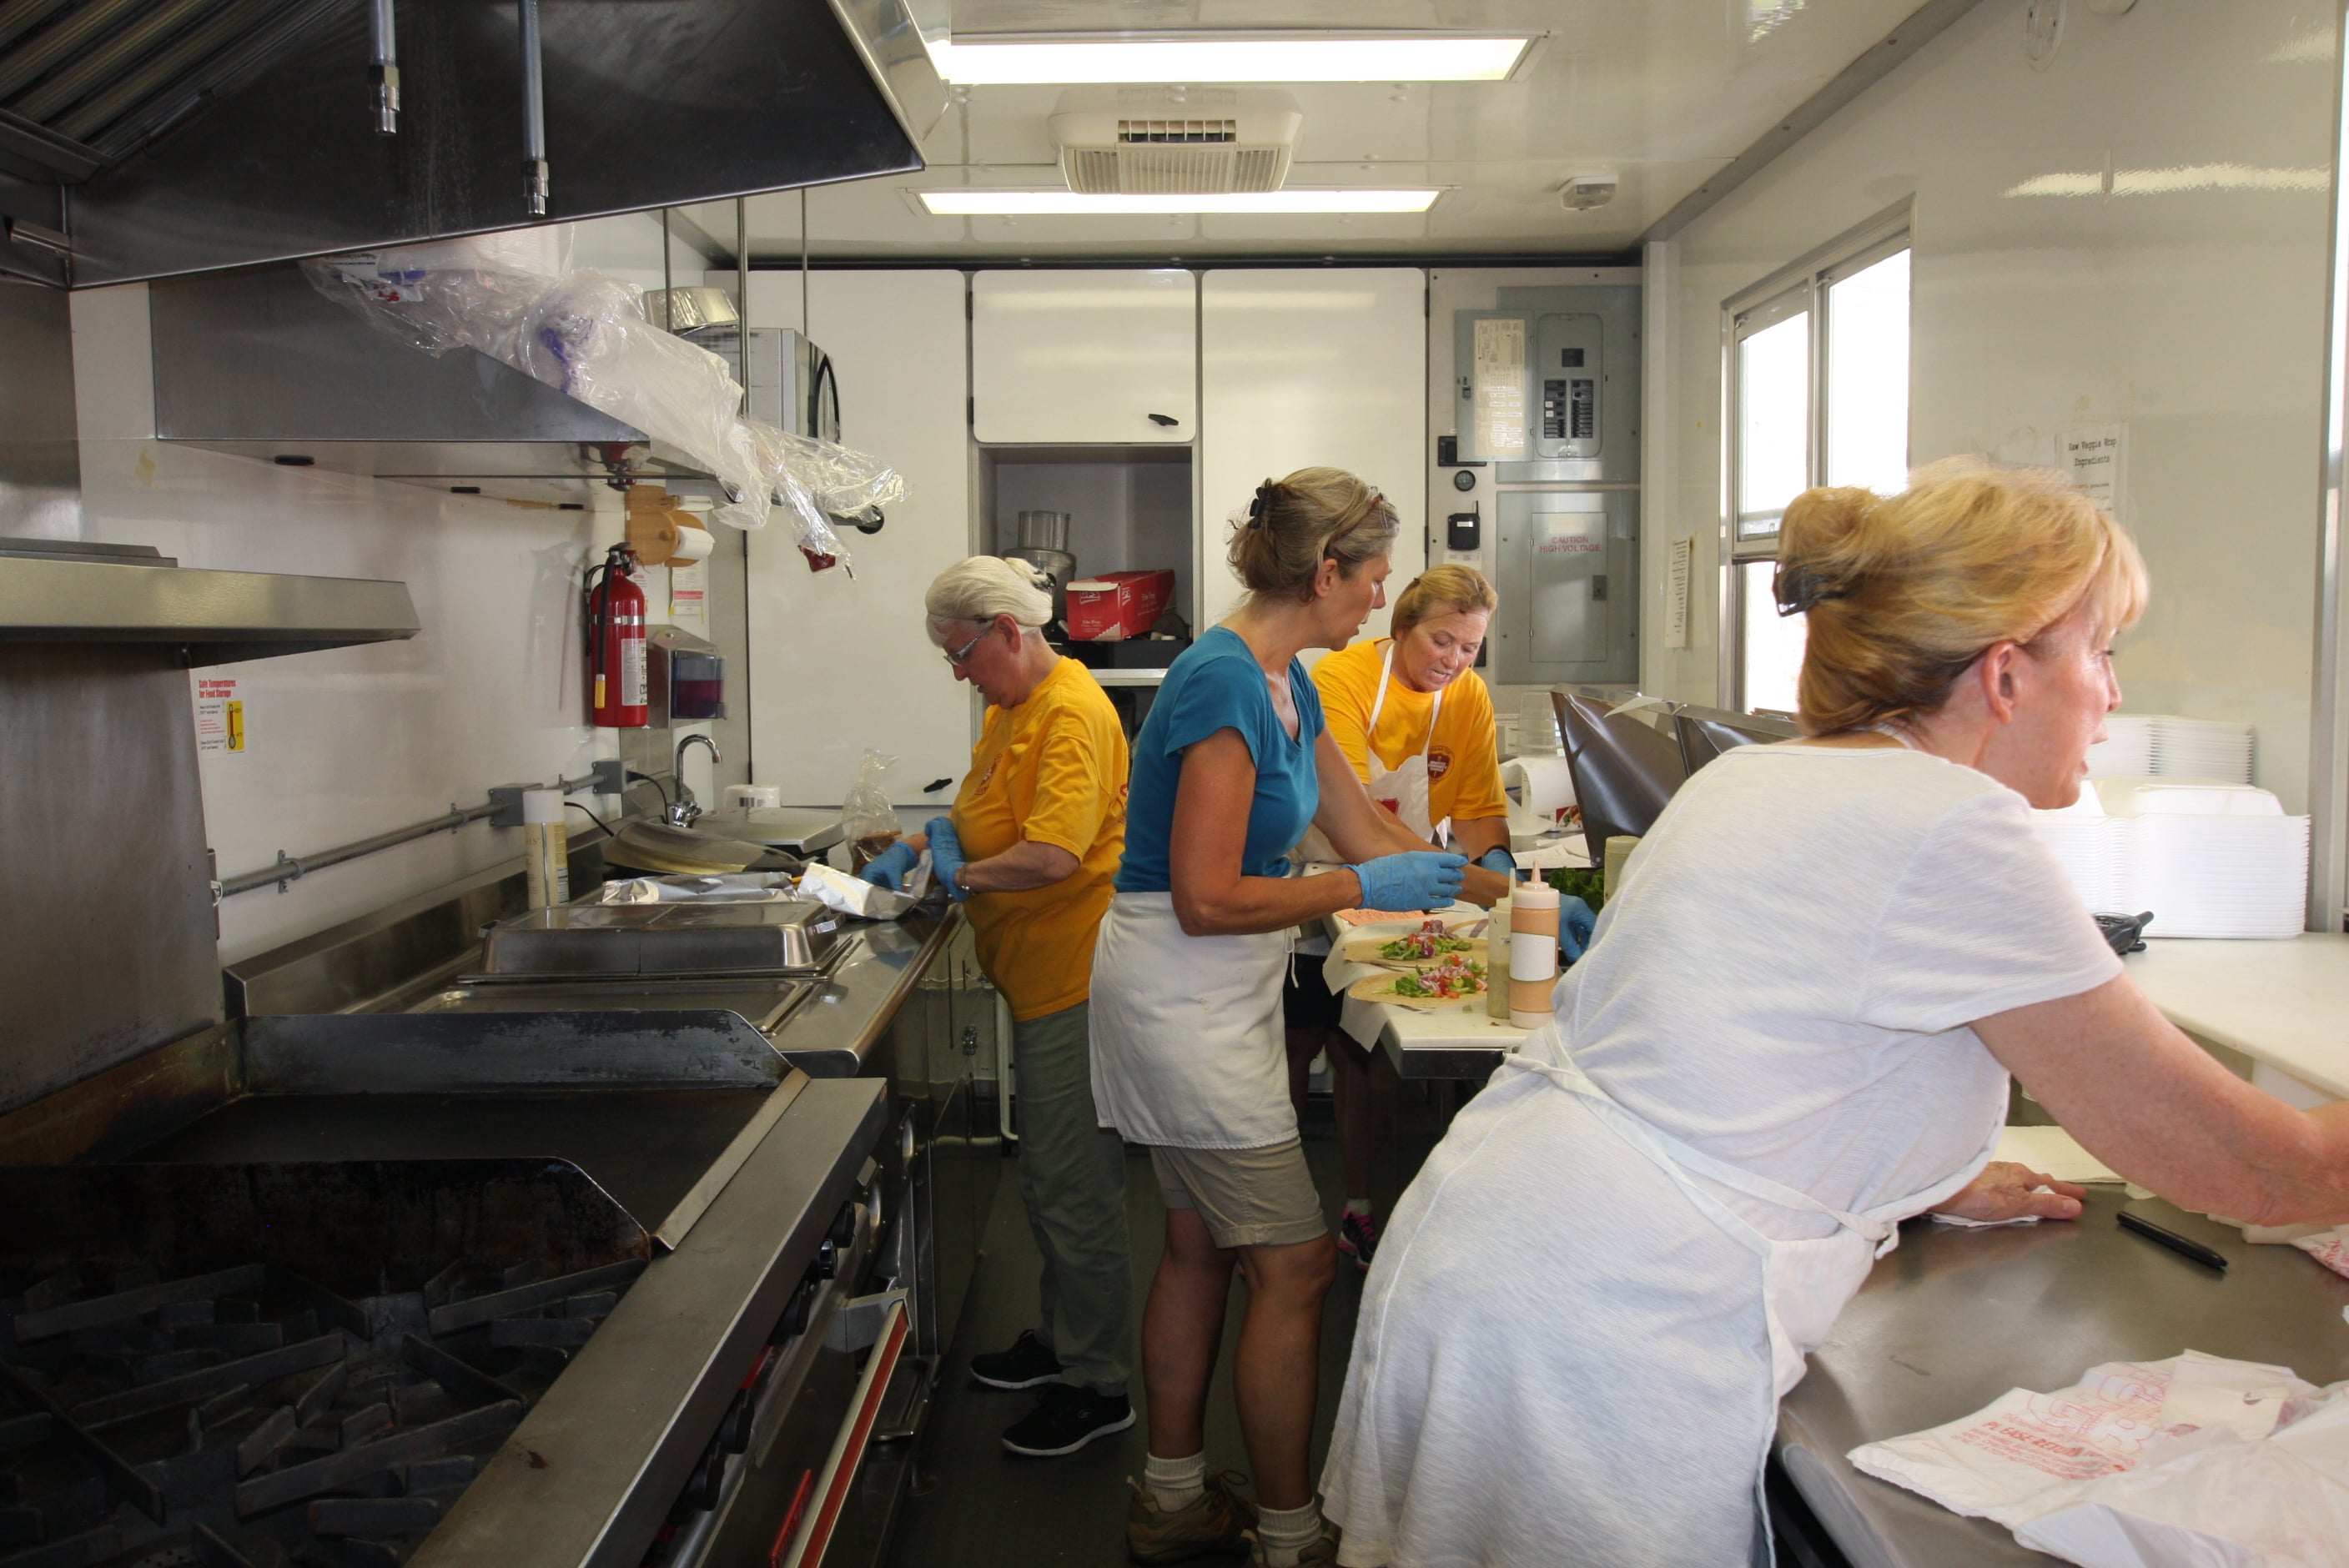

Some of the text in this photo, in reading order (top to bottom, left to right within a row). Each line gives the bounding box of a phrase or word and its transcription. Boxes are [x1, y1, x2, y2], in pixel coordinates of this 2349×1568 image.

[2075, 455, 2110, 468] Ingredients
[1552, 535, 1589, 544] CAUTION
[1540, 544, 1602, 553] HIGH VOLTAGE
[209, 679, 236, 688] Temperatures
[206, 689, 214, 698] Food
[215, 689, 232, 699] Storage
